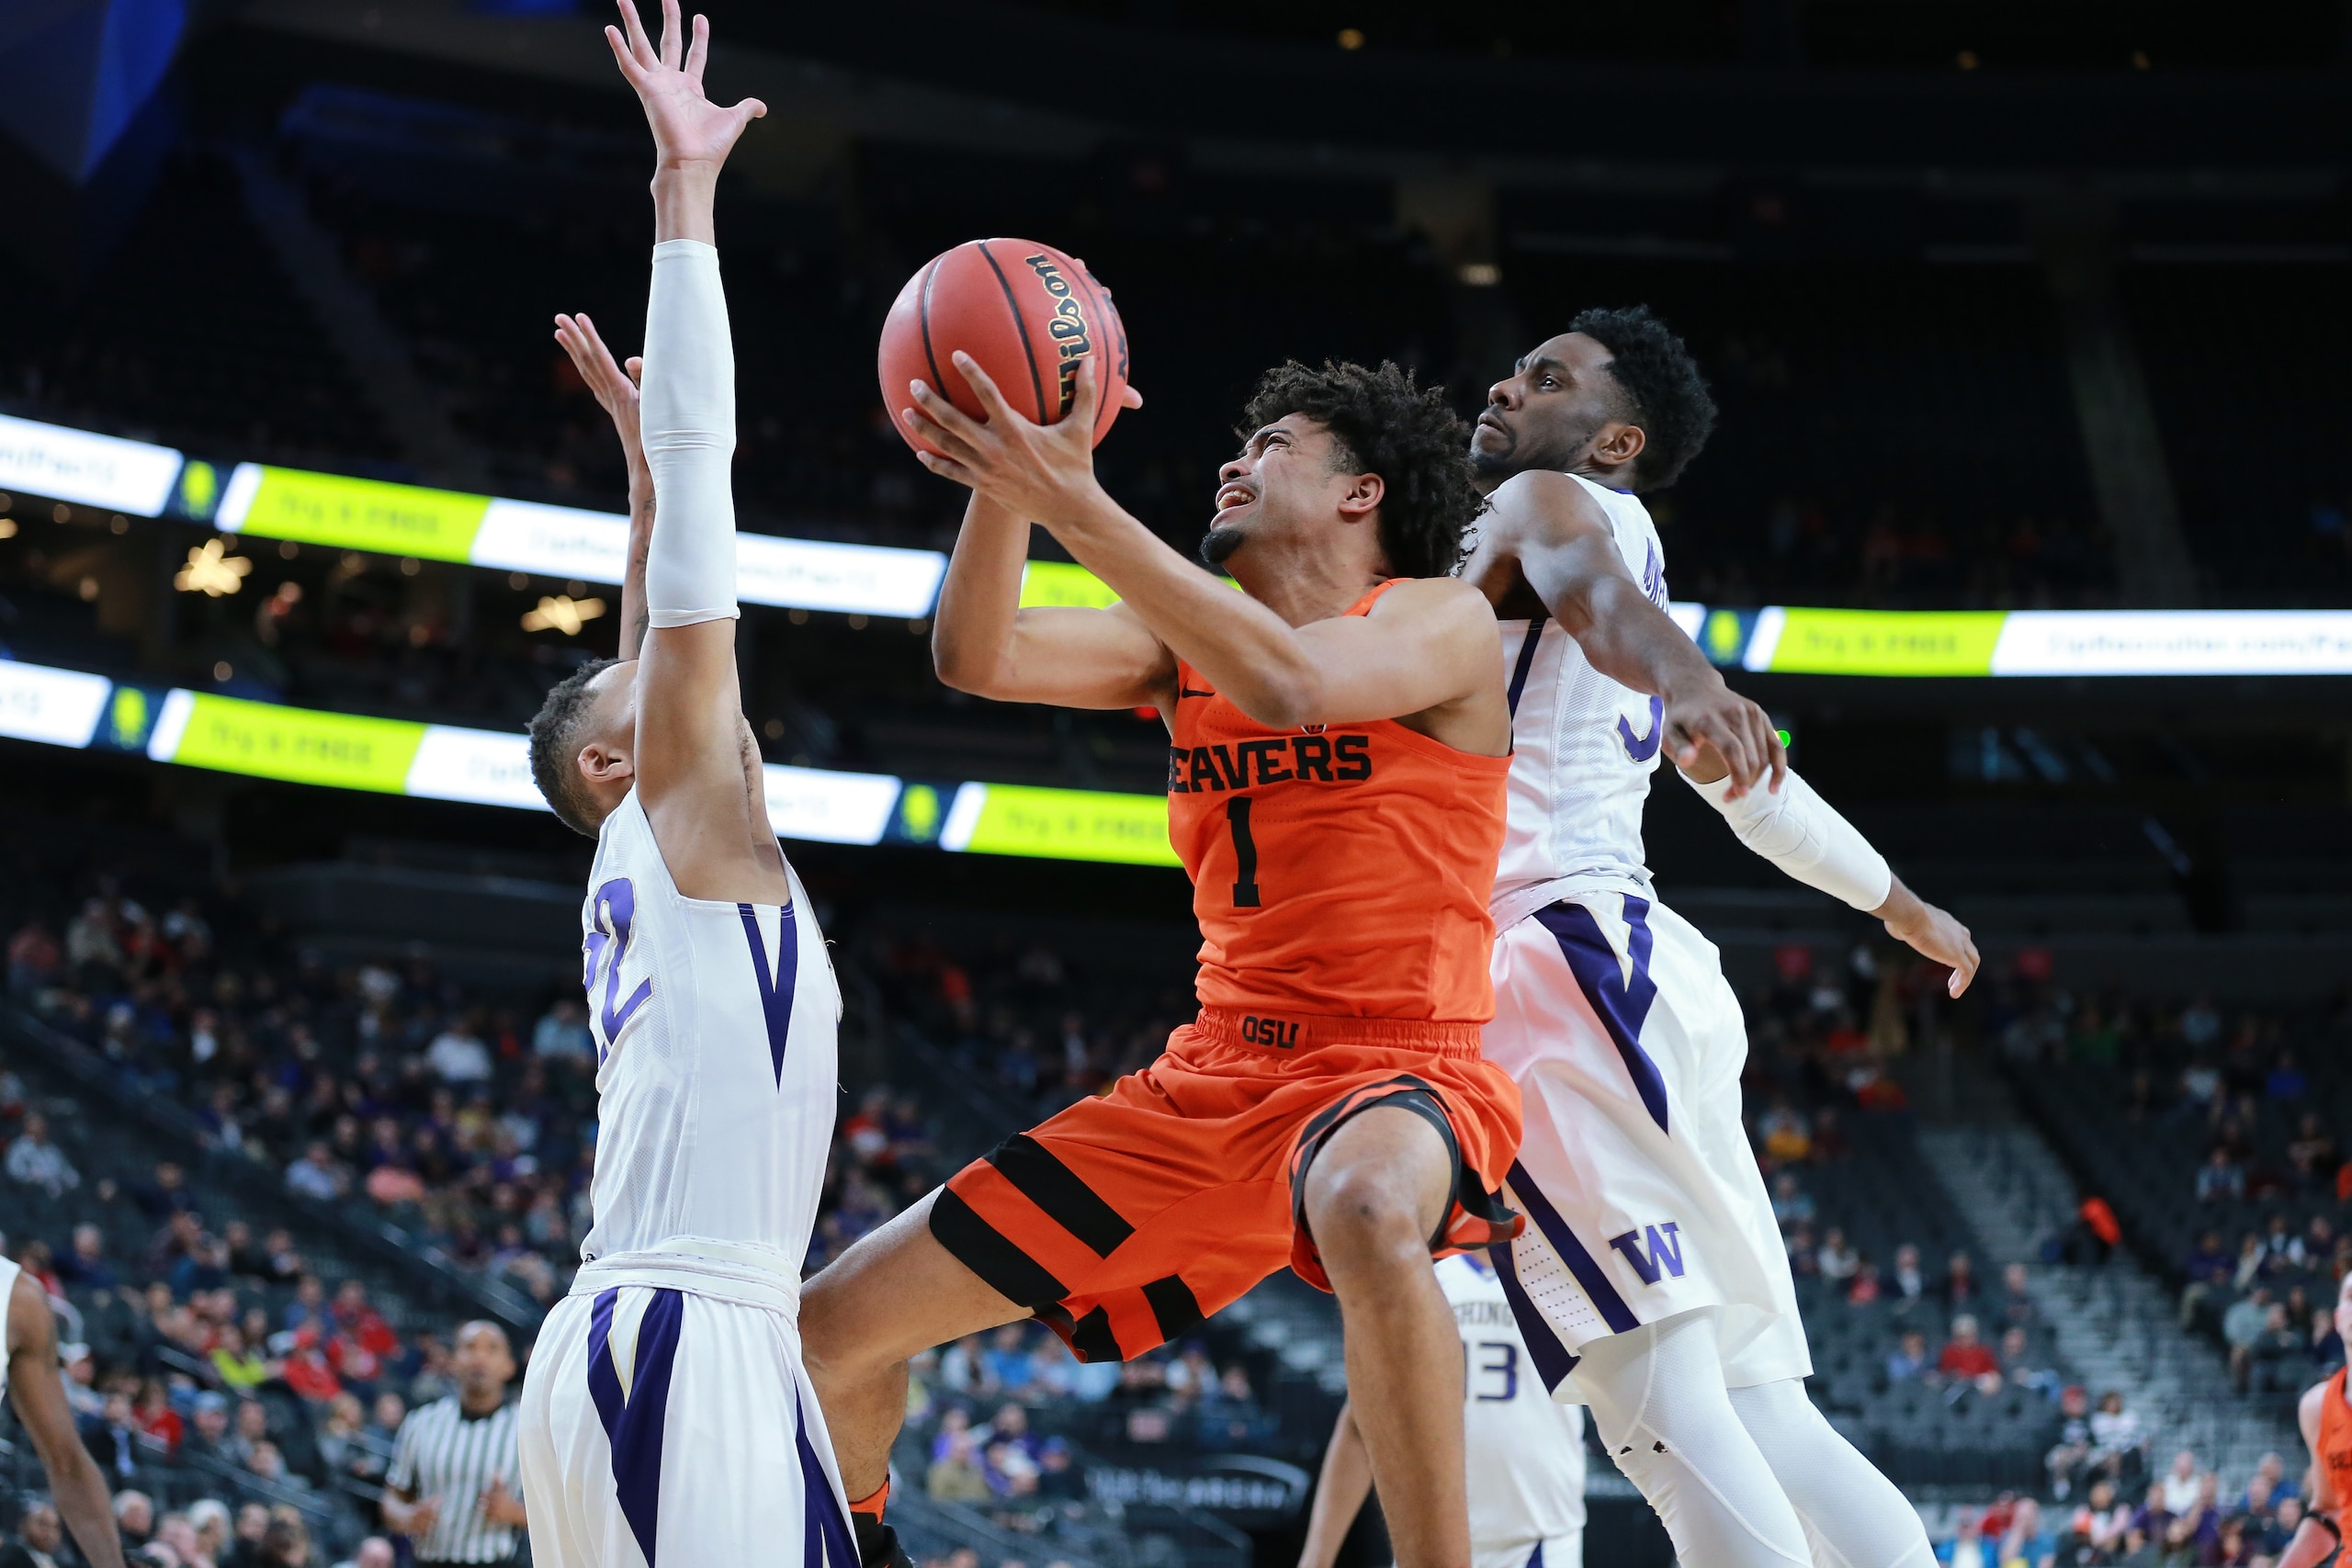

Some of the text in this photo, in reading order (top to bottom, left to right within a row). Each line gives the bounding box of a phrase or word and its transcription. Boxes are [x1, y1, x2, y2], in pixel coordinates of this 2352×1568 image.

[1168, 735, 1372, 793] EAVERS
[1227, 795, 1262, 908] 1
[1242, 1015, 1299, 1049] OSU
[1607, 1220, 1686, 1288] W
